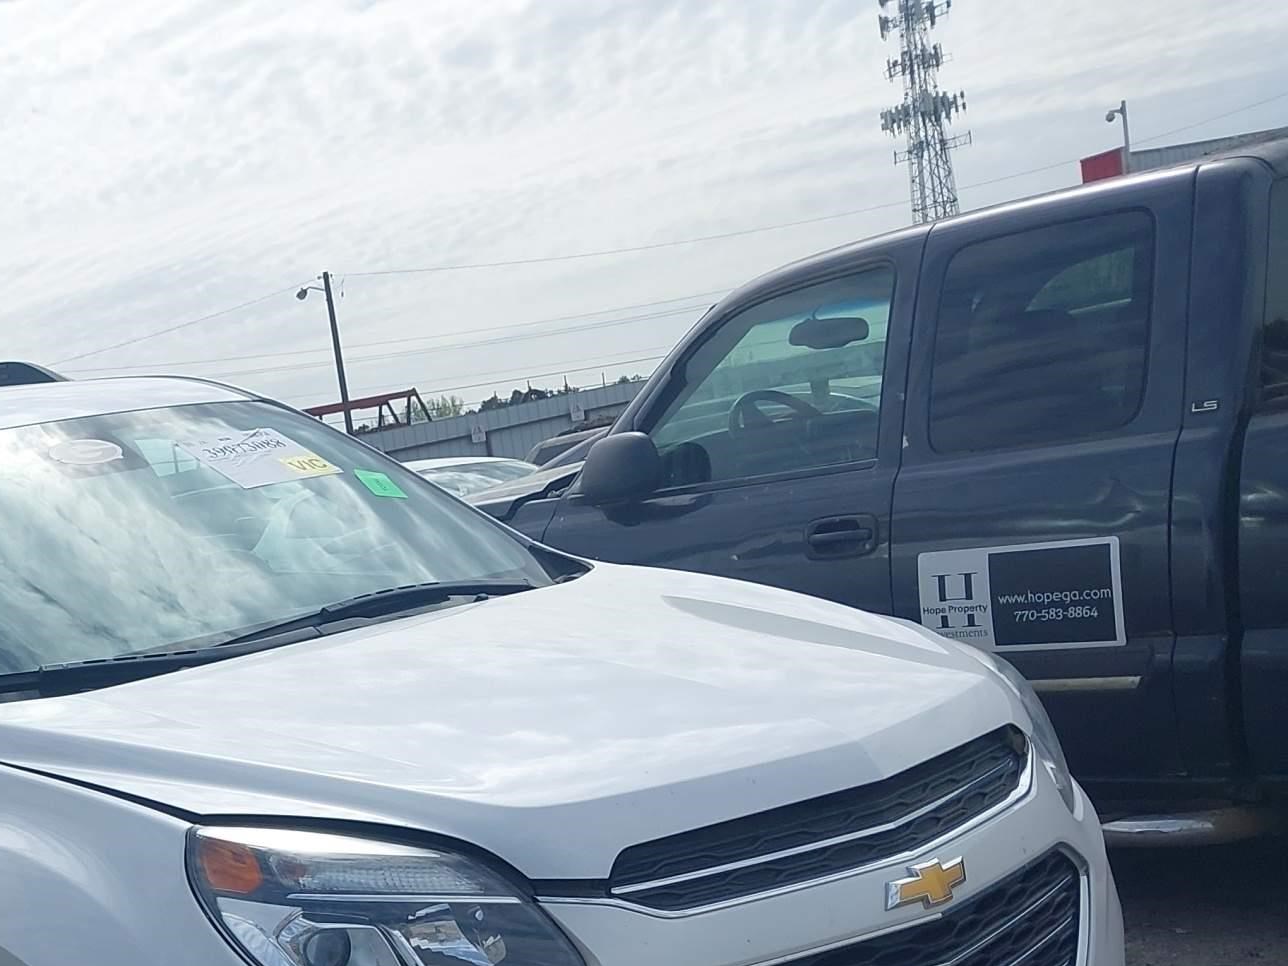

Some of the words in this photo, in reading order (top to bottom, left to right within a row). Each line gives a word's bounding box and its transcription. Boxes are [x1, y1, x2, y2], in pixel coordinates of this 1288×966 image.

[1191, 400, 1218, 412] LS
[998, 586, 1112, 605] www.hopega.com
[922, 606, 947, 615] Hope
[948, 604, 988, 614] Property
[1014, 606, 1099, 623] 770-583-8864
